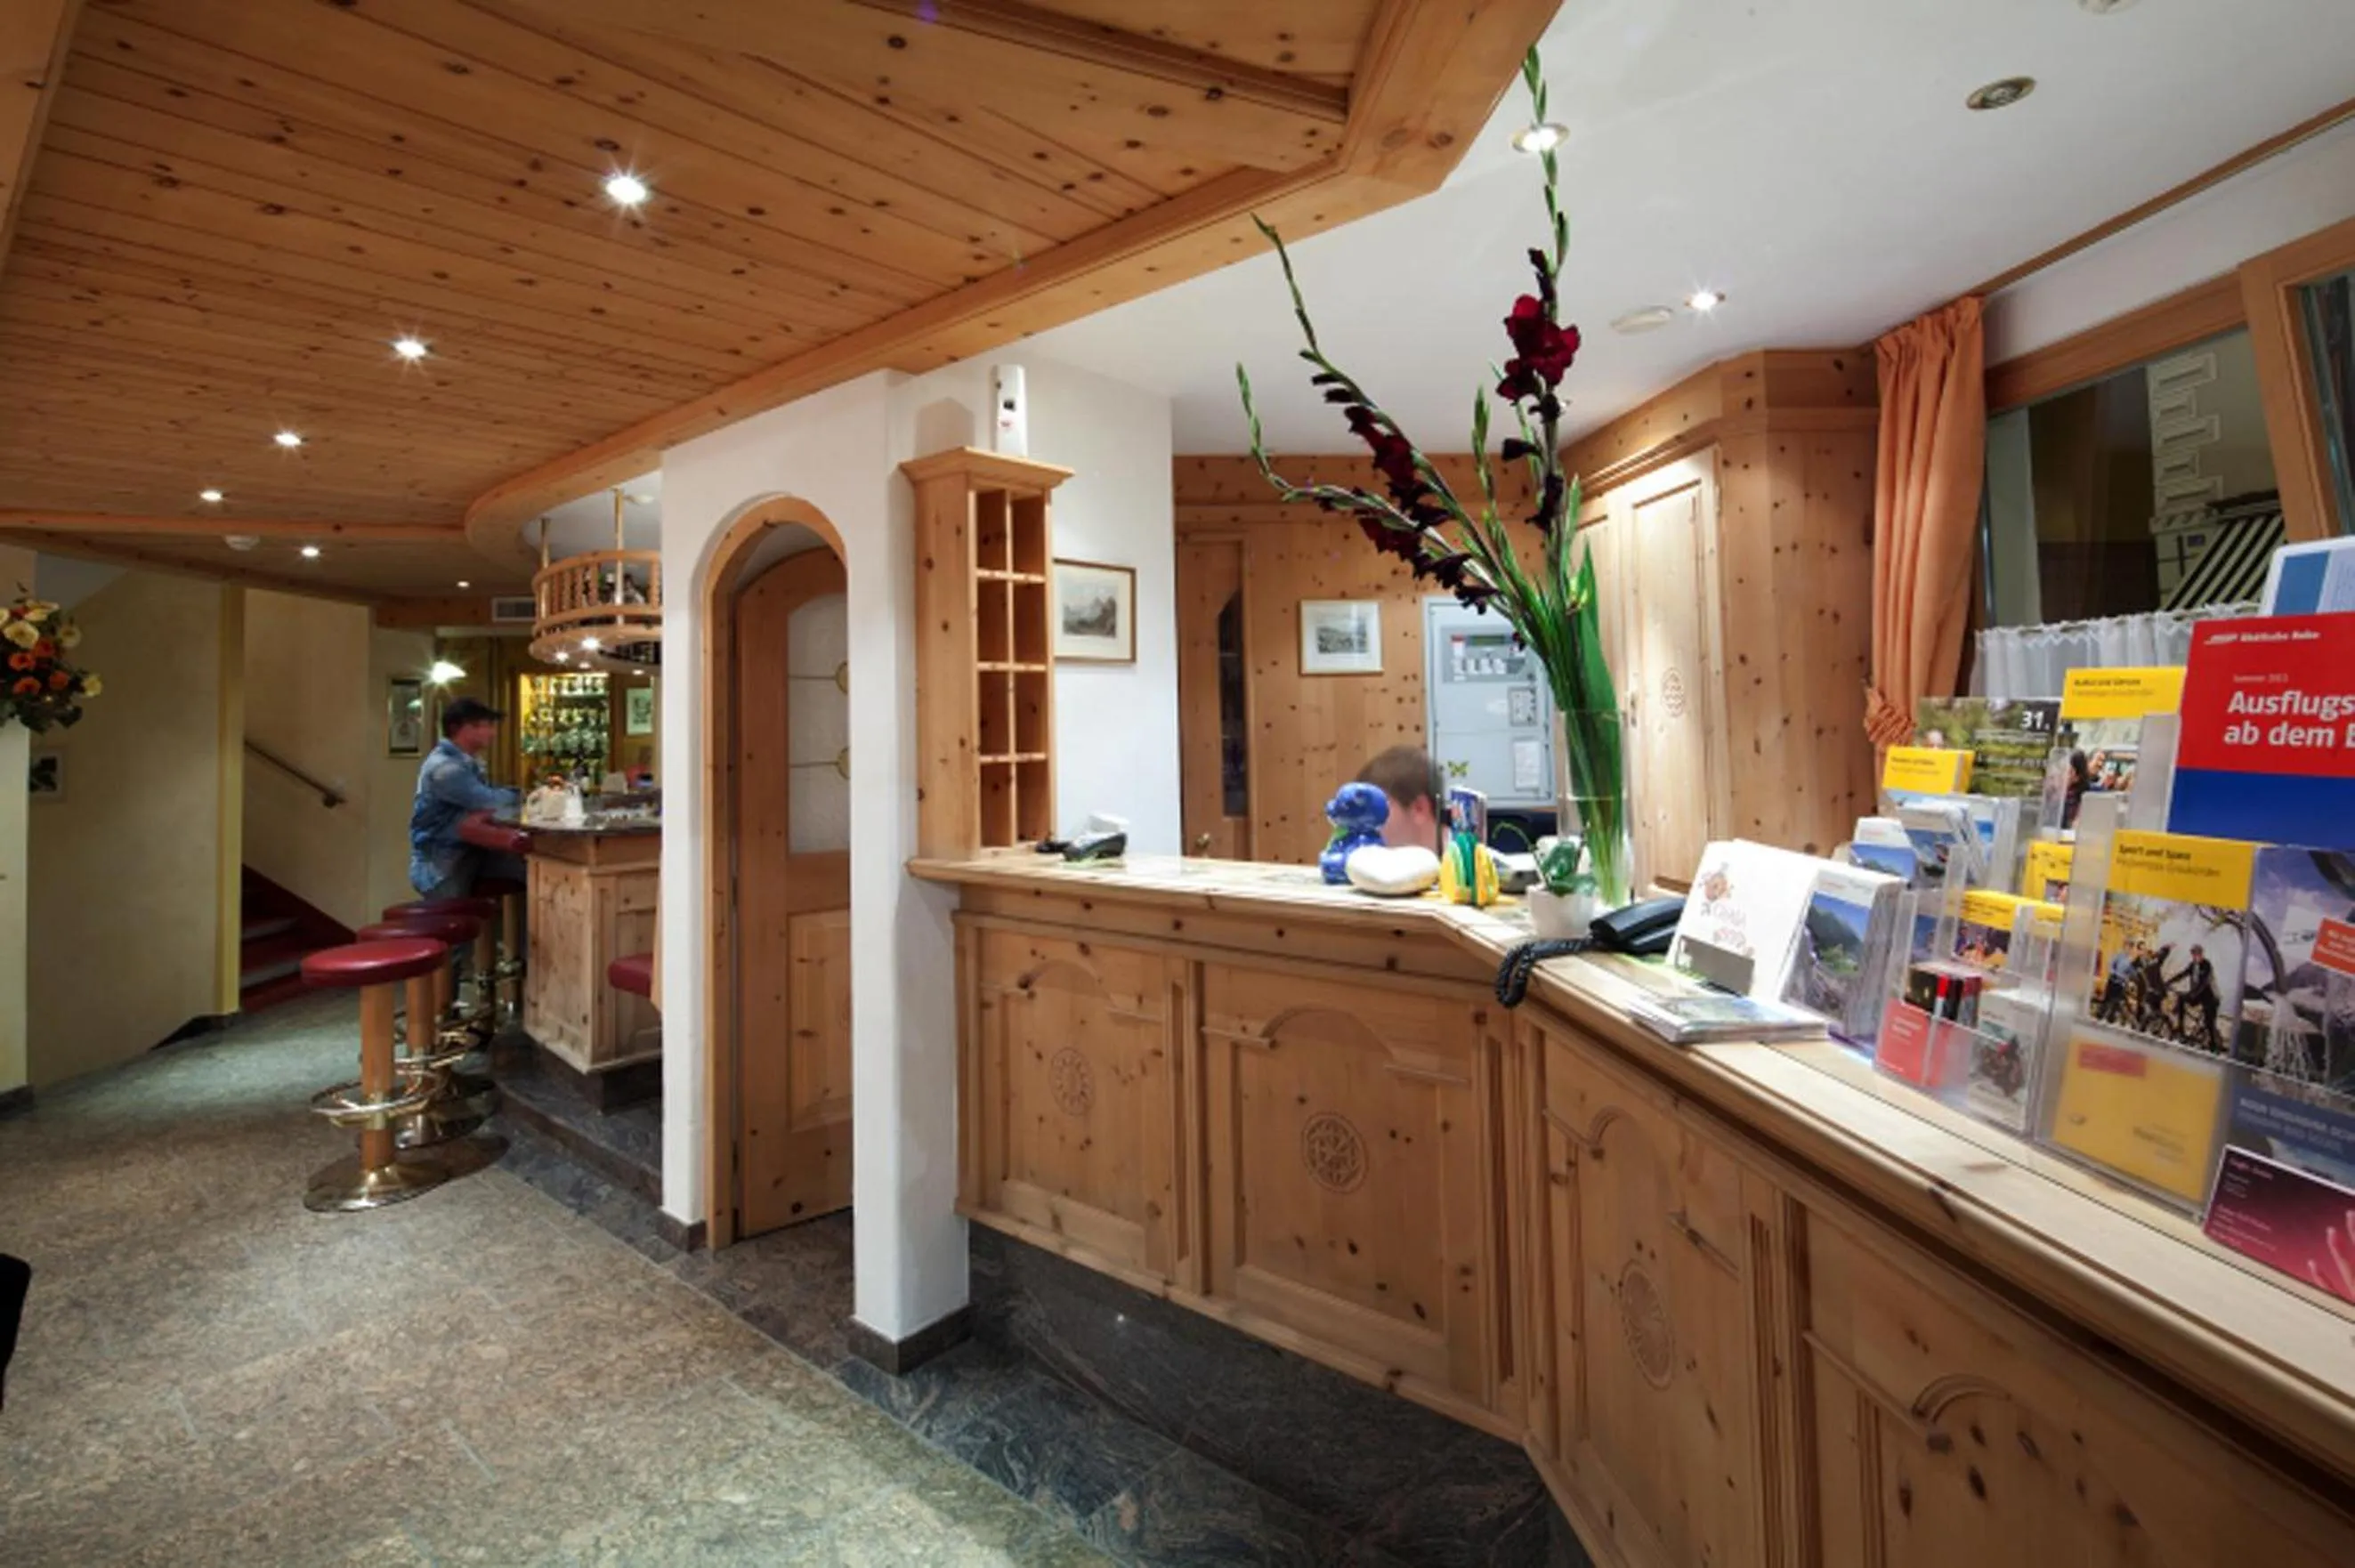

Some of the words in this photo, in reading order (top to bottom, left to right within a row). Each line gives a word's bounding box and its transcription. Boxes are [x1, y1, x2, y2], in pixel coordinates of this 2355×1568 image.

[2227, 690, 2355, 722] Ausflugs
[2223, 720, 2260, 746] ab
[2267, 721, 2335, 748] dem
